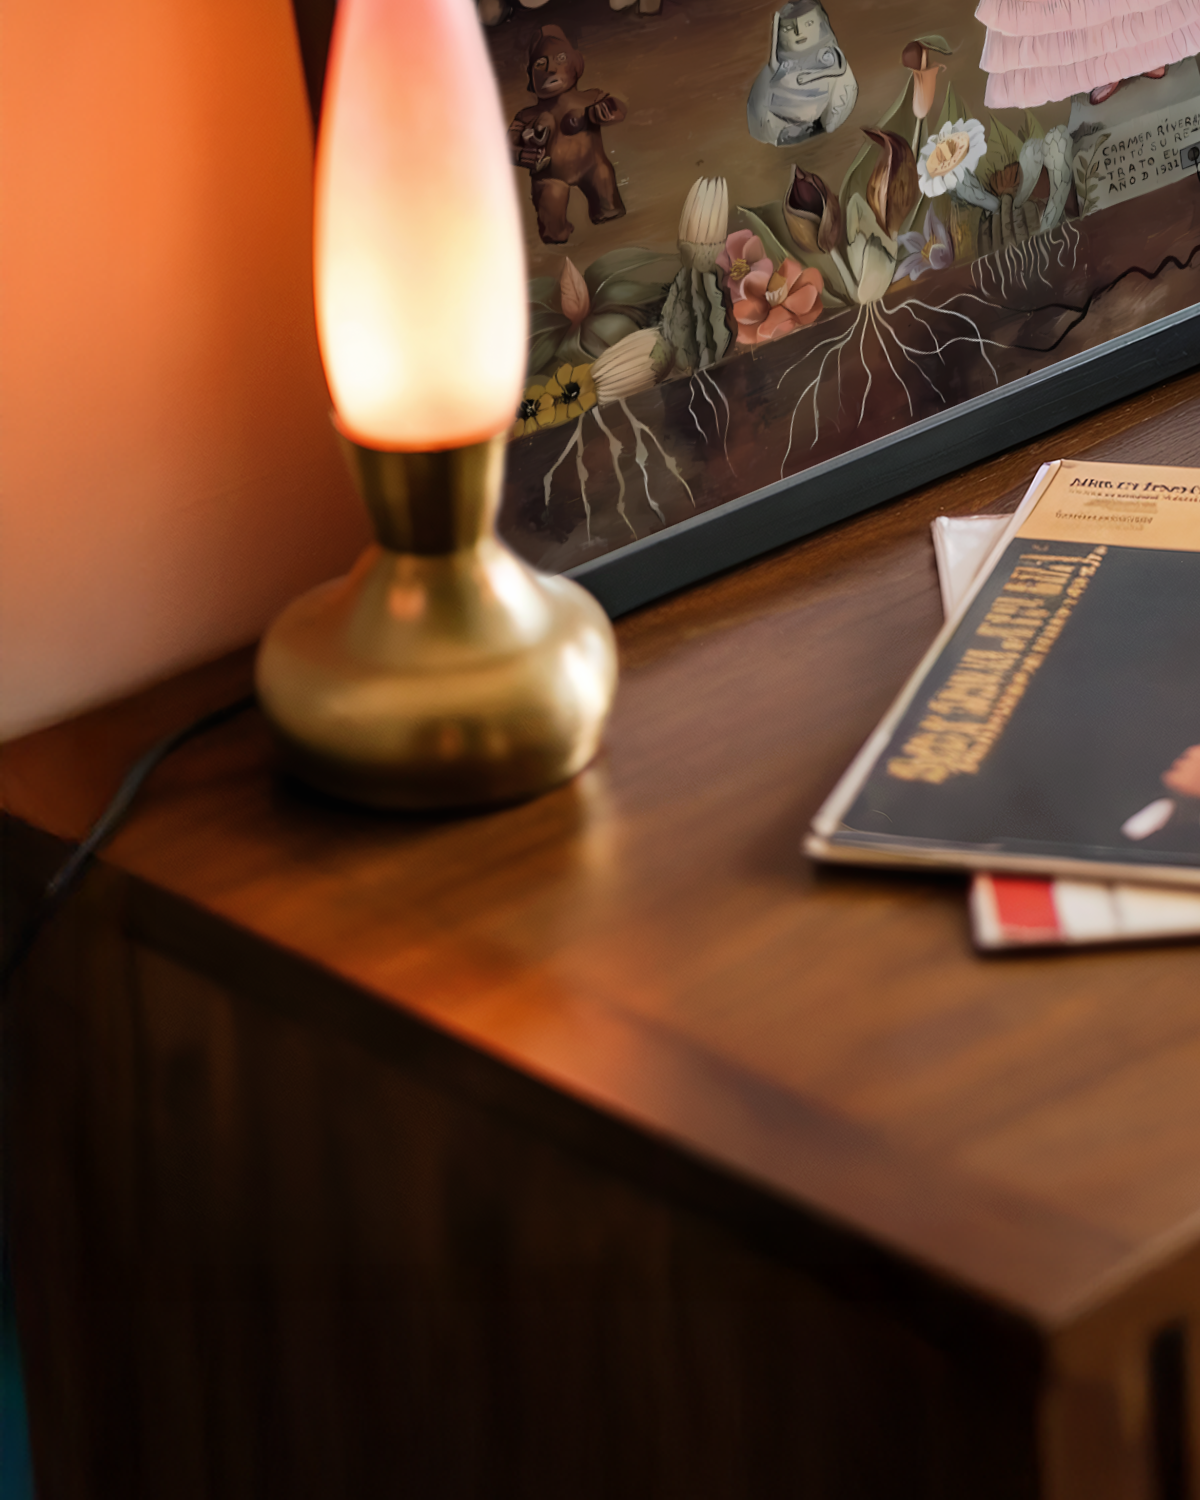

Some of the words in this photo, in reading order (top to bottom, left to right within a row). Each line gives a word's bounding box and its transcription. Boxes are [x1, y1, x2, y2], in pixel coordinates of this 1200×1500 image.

[1102, 131, 1152, 157] CARMEN
[1150, 138, 1167, 152] SU
[1108, 176, 1136, 194] AÑO
[1141, 171, 1149, 181] D
